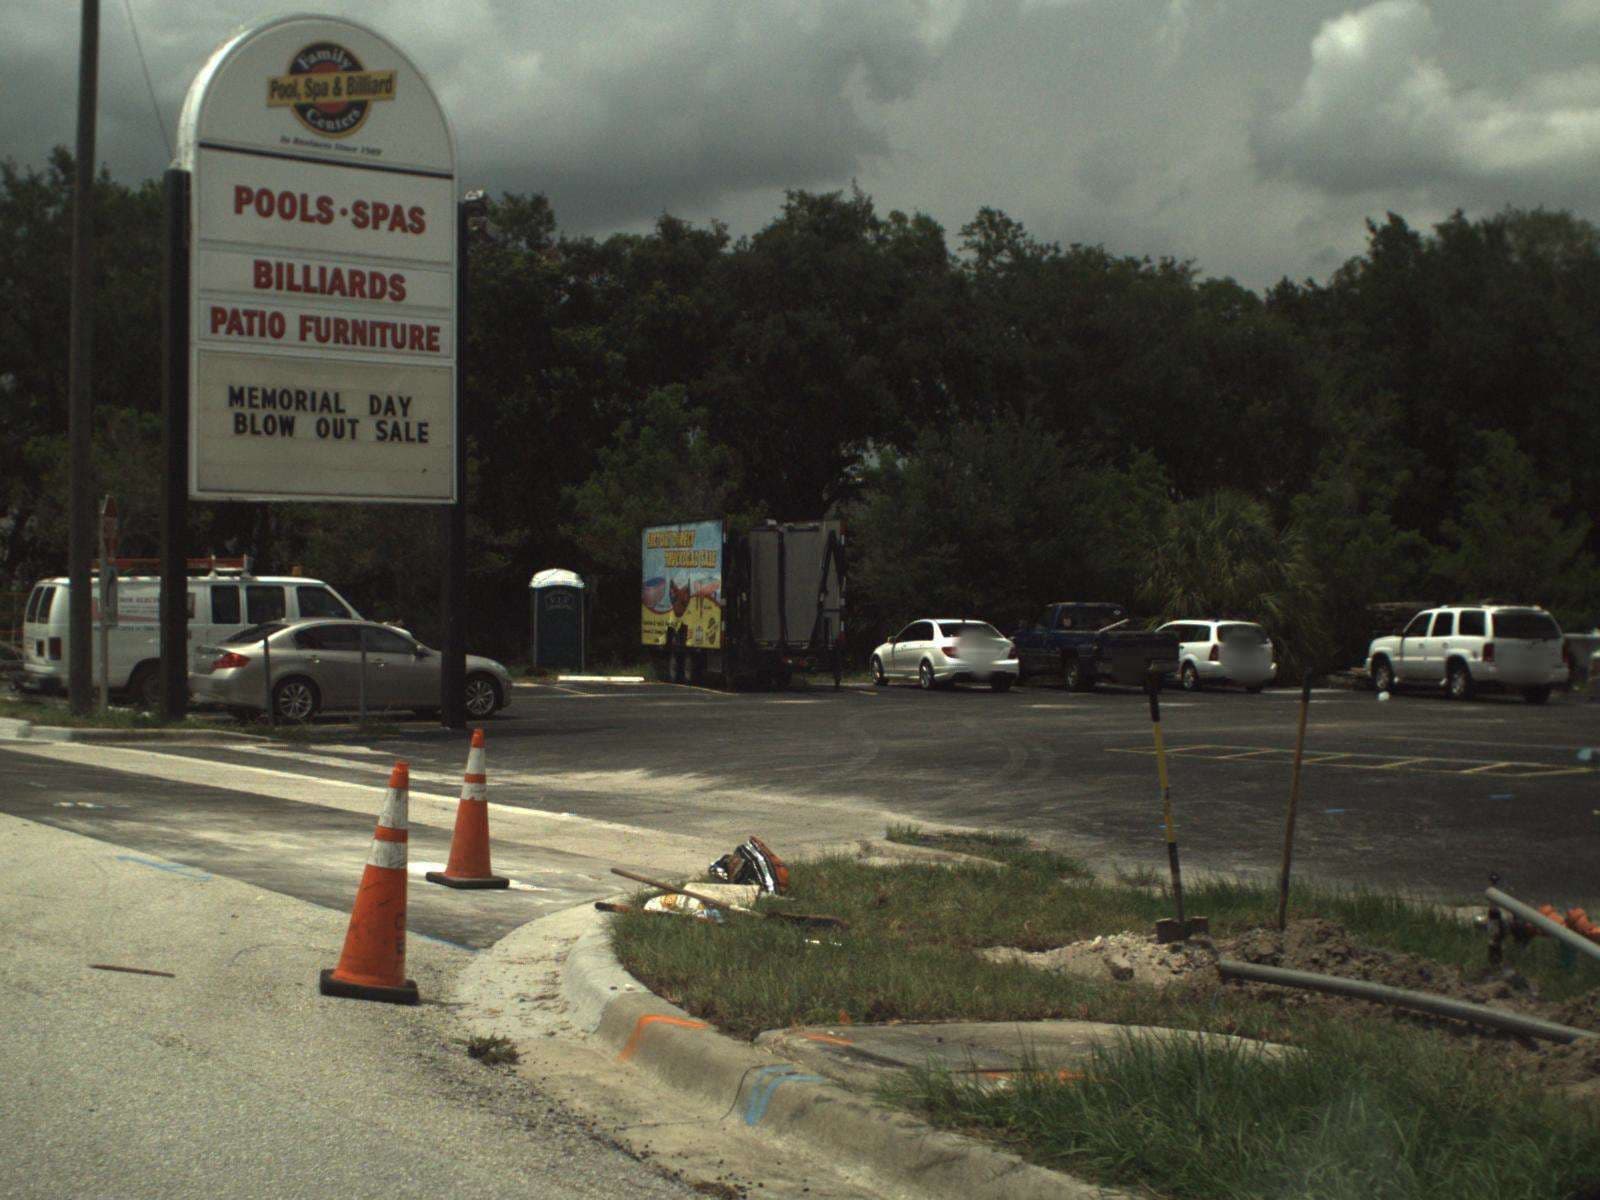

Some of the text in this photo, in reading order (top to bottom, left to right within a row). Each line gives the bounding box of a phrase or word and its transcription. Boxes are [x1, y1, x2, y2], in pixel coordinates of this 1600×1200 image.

[297, 48, 353, 70] Family
[304, 78, 330, 101] Spa
[332, 76, 342, 97] &
[347, 74, 393, 96] Billiard
[306, 108, 361, 131] Centers
[253, 259, 407, 302] BILLIARDS
[210, 306, 440, 352] PATIO FURNITURE
[228, 385, 412, 418] MEMORIAL DAY
[234, 412, 430, 443] BLOW OUT SALE
